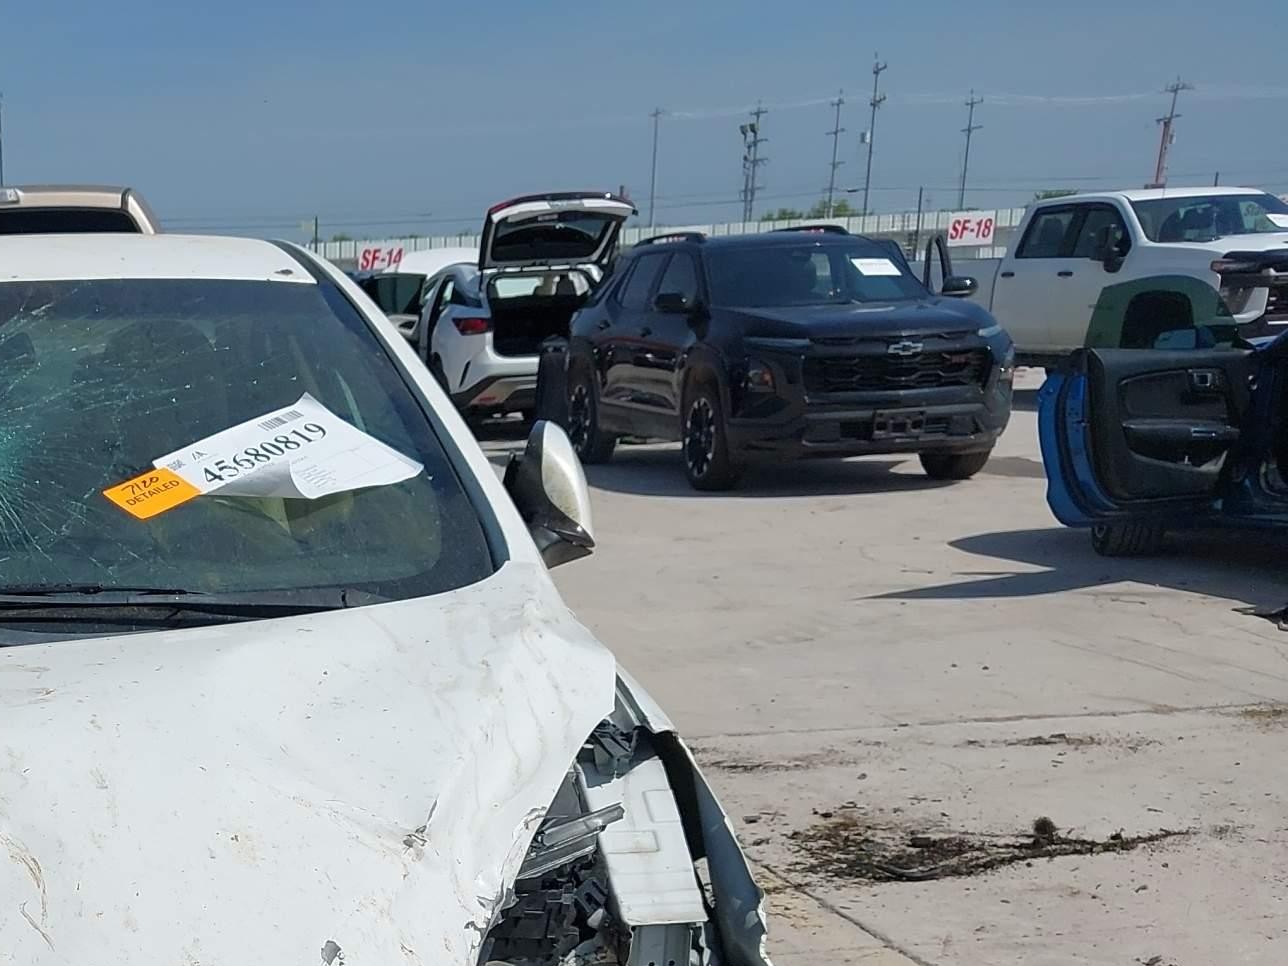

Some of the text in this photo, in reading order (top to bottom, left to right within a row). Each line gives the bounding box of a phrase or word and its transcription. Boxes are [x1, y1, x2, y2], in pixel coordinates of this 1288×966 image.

[950, 218, 993, 240] SF-18
[360, 247, 404, 270] SF-14
[203, 422, 327, 483] 45680819
[126, 480, 180, 506] DETAILED
